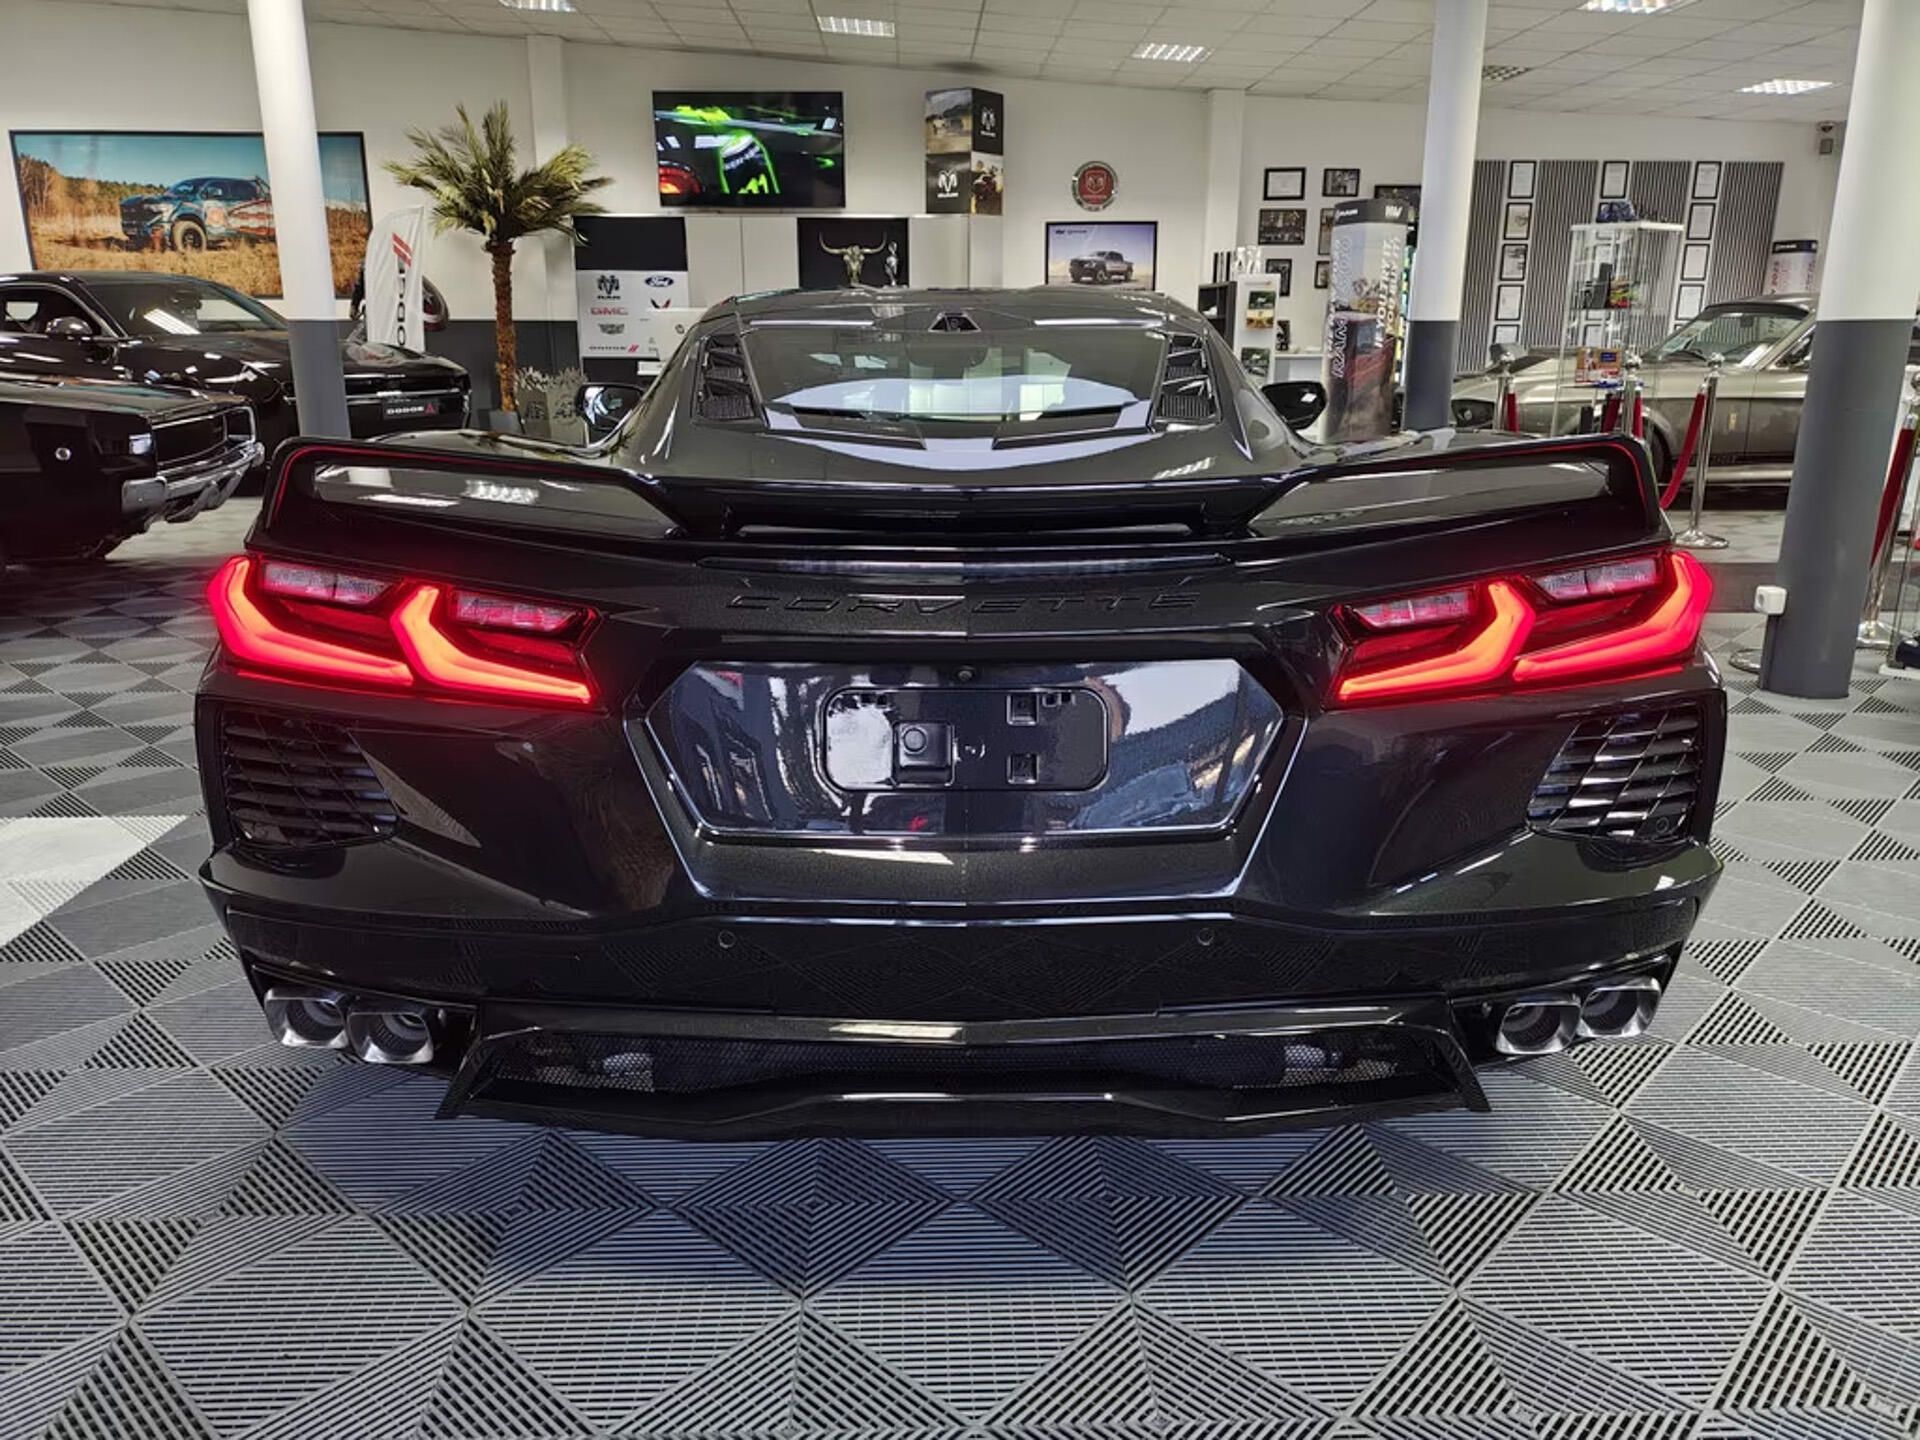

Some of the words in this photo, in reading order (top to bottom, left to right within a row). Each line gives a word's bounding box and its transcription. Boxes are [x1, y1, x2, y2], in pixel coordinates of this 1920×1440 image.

[591, 306, 627, 316] GMC
[1375, 293, 1387, 329] YOU
[1386, 299, 1395, 334] YOU
[1332, 315, 1348, 378] RAM
[1374, 331, 1384, 348] IF
[725, 592, 1200, 615] CORVETTE
